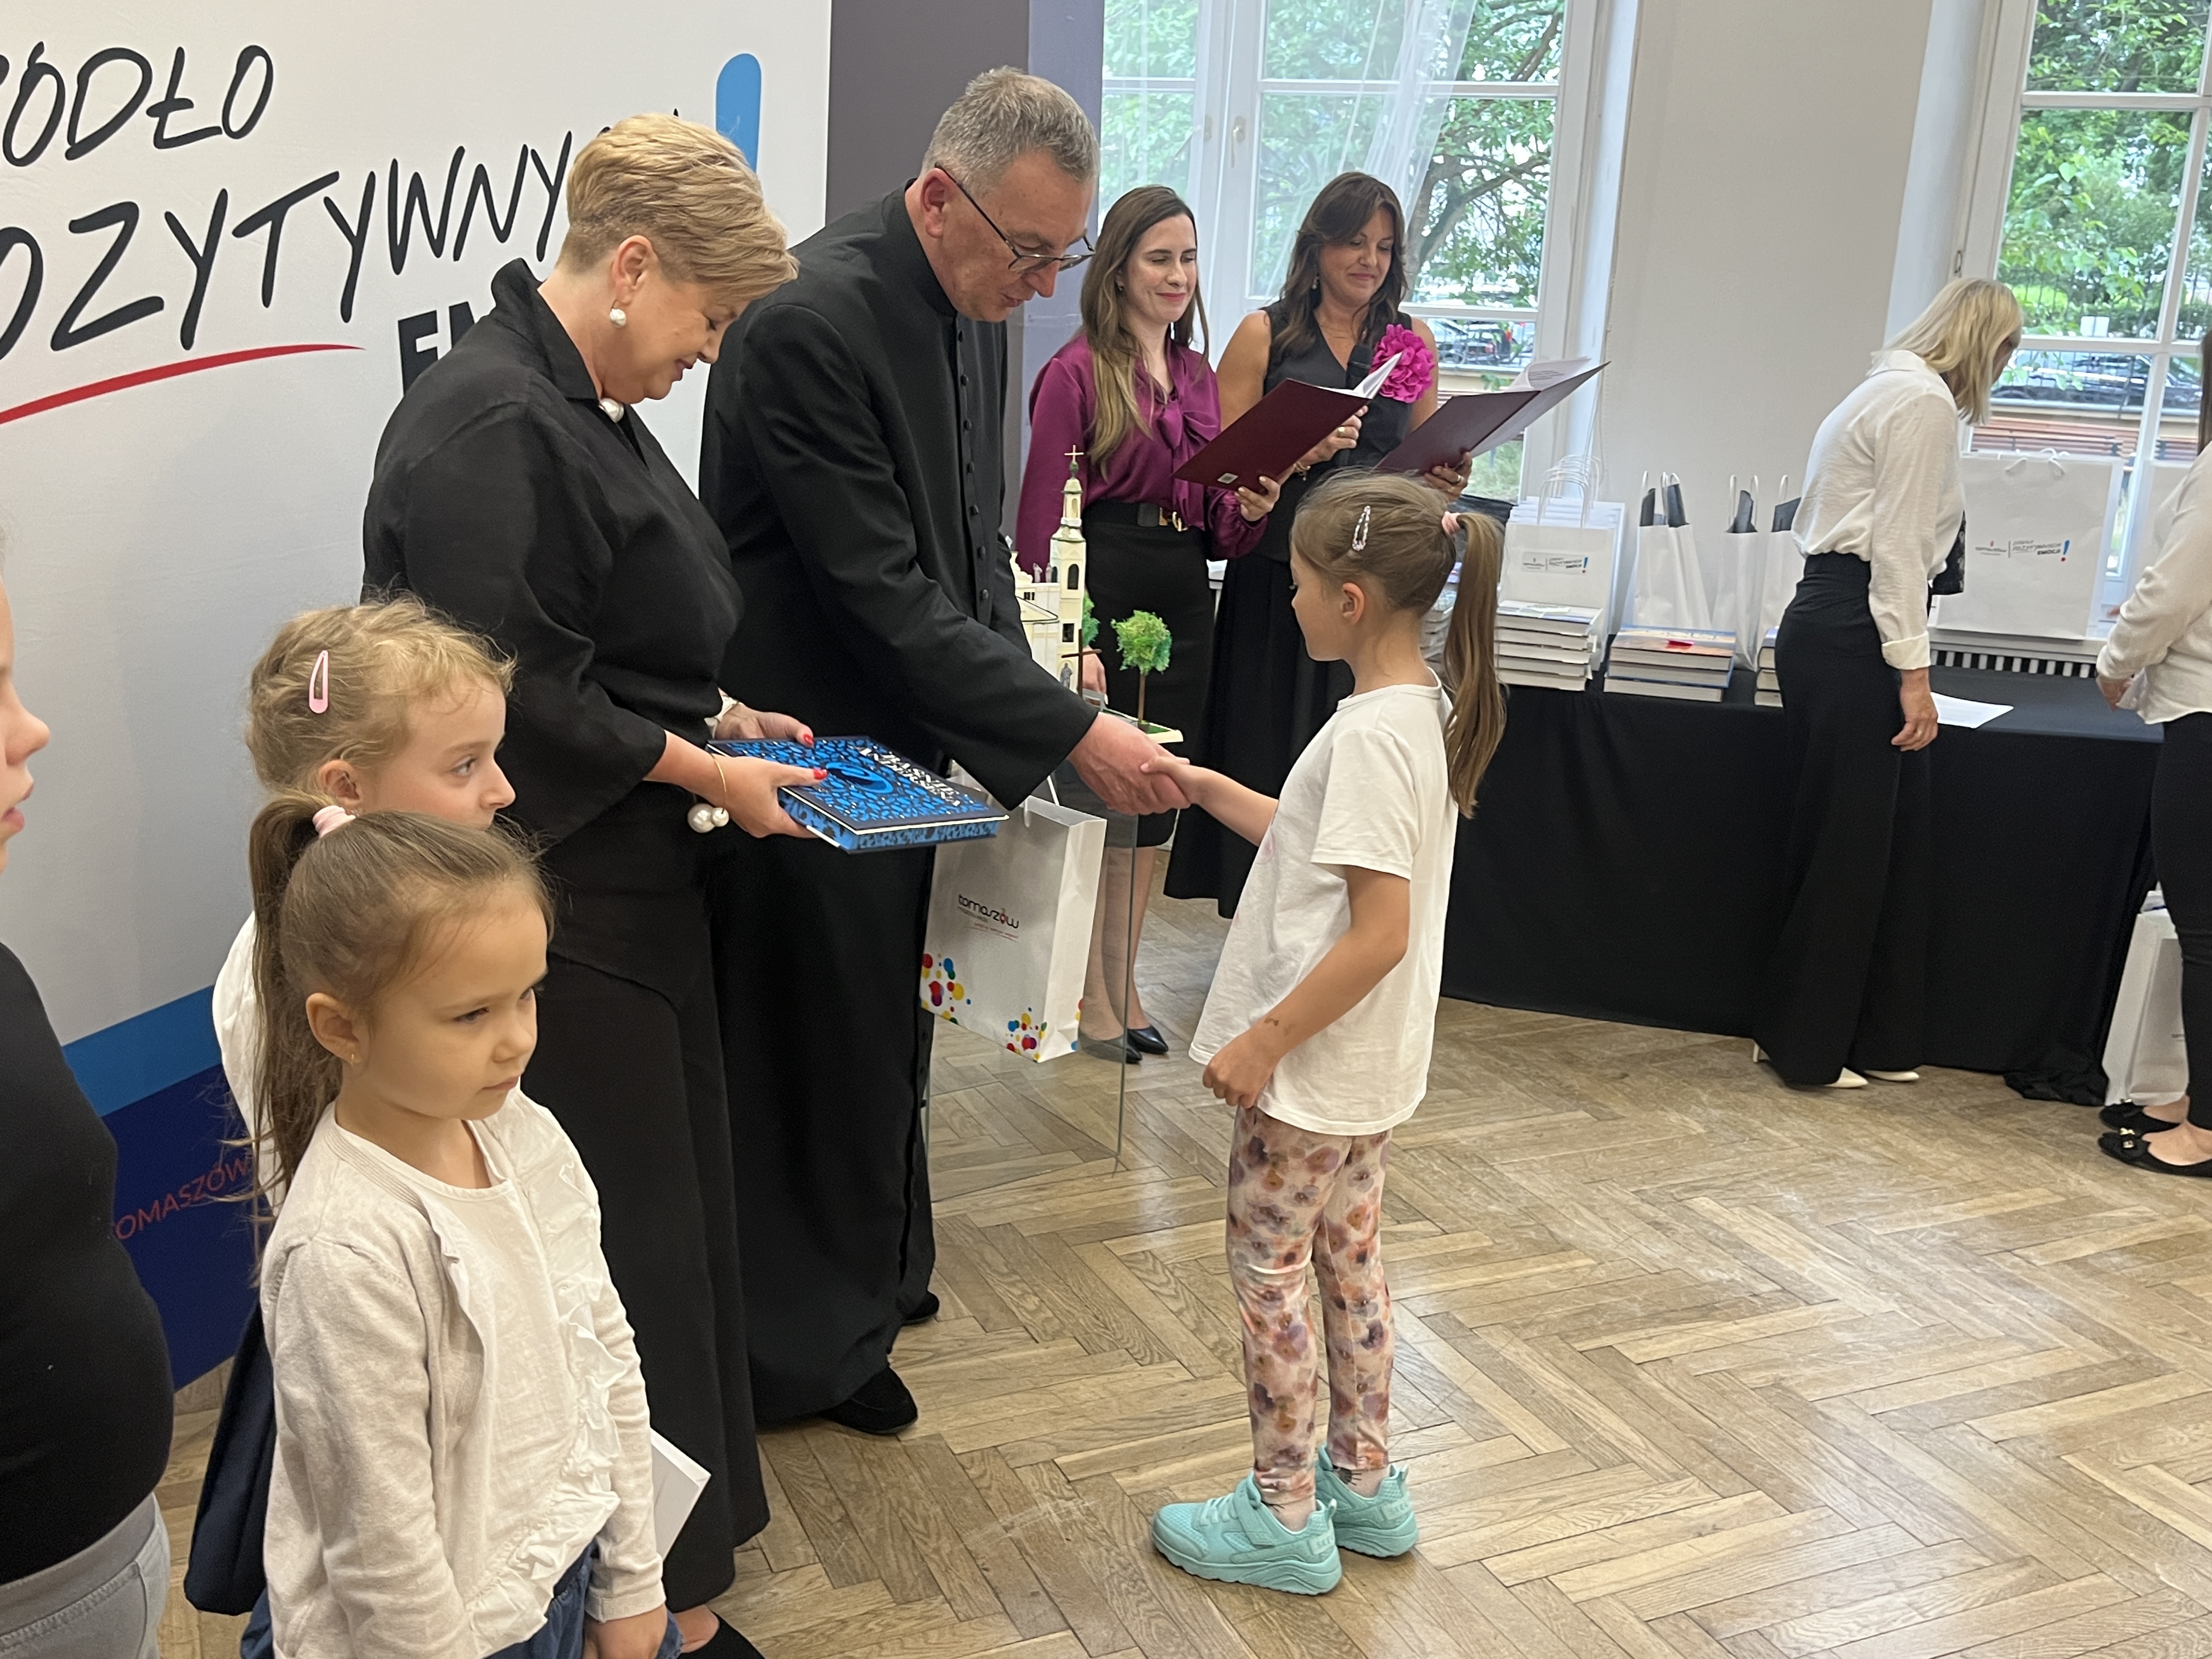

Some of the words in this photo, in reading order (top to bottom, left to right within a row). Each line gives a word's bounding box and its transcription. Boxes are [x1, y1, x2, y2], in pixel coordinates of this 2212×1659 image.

[0, 42, 273, 166] ÓDŁO
[0, 127, 611, 360] OZYTYWNY
[114, 1157, 250, 1240] OMASZÓW
